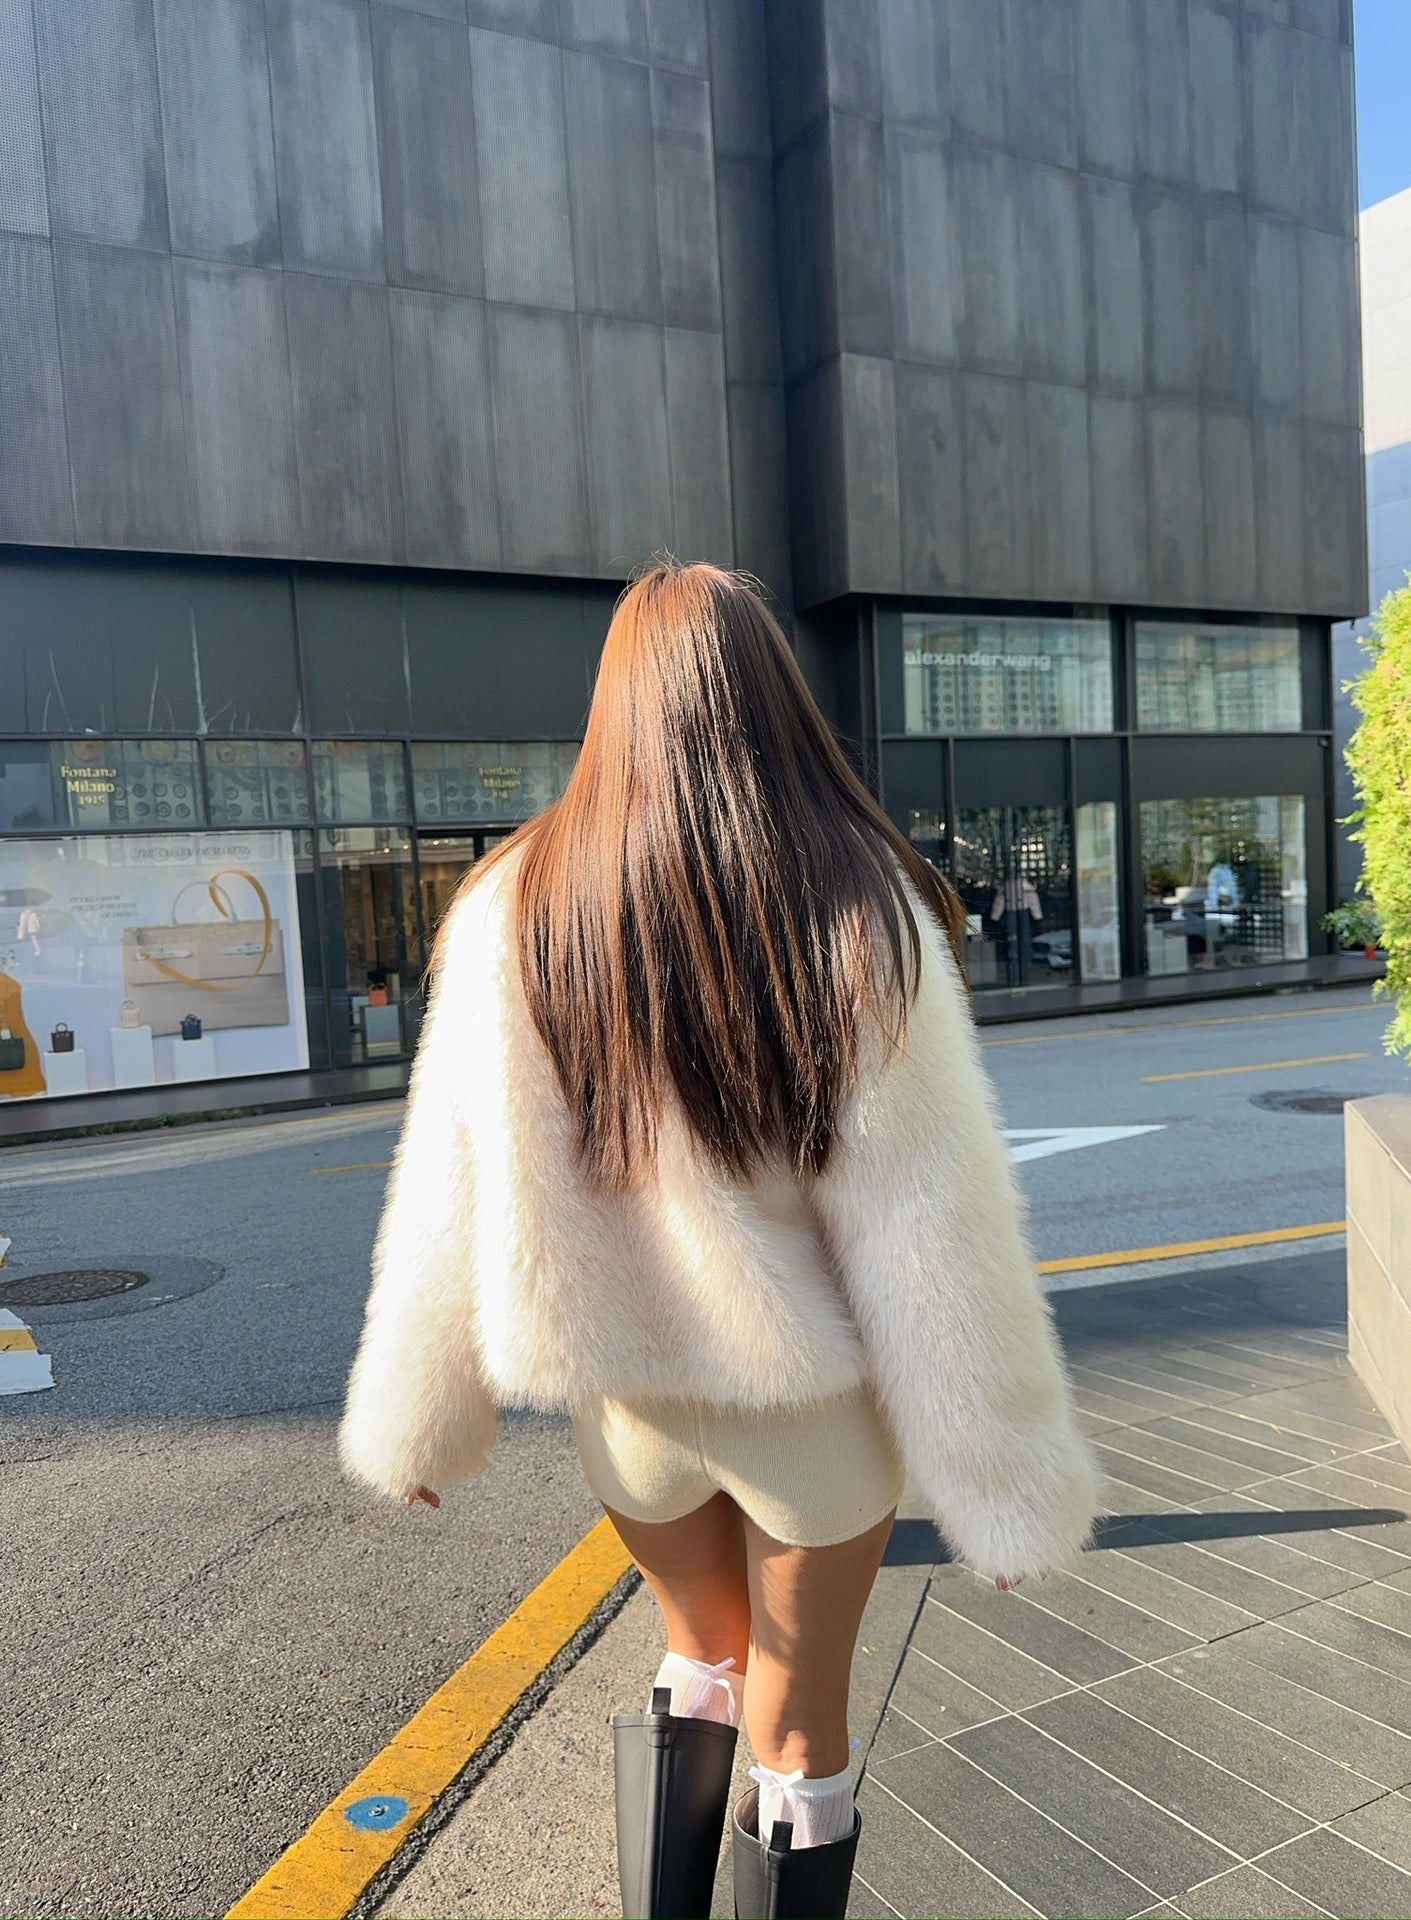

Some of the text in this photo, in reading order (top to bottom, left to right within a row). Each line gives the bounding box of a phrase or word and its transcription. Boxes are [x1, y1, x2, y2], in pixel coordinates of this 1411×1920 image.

[904, 650, 1051, 671] alexanderwang
[61, 765, 117, 778] Fontana
[66, 780, 115, 793] Milano
